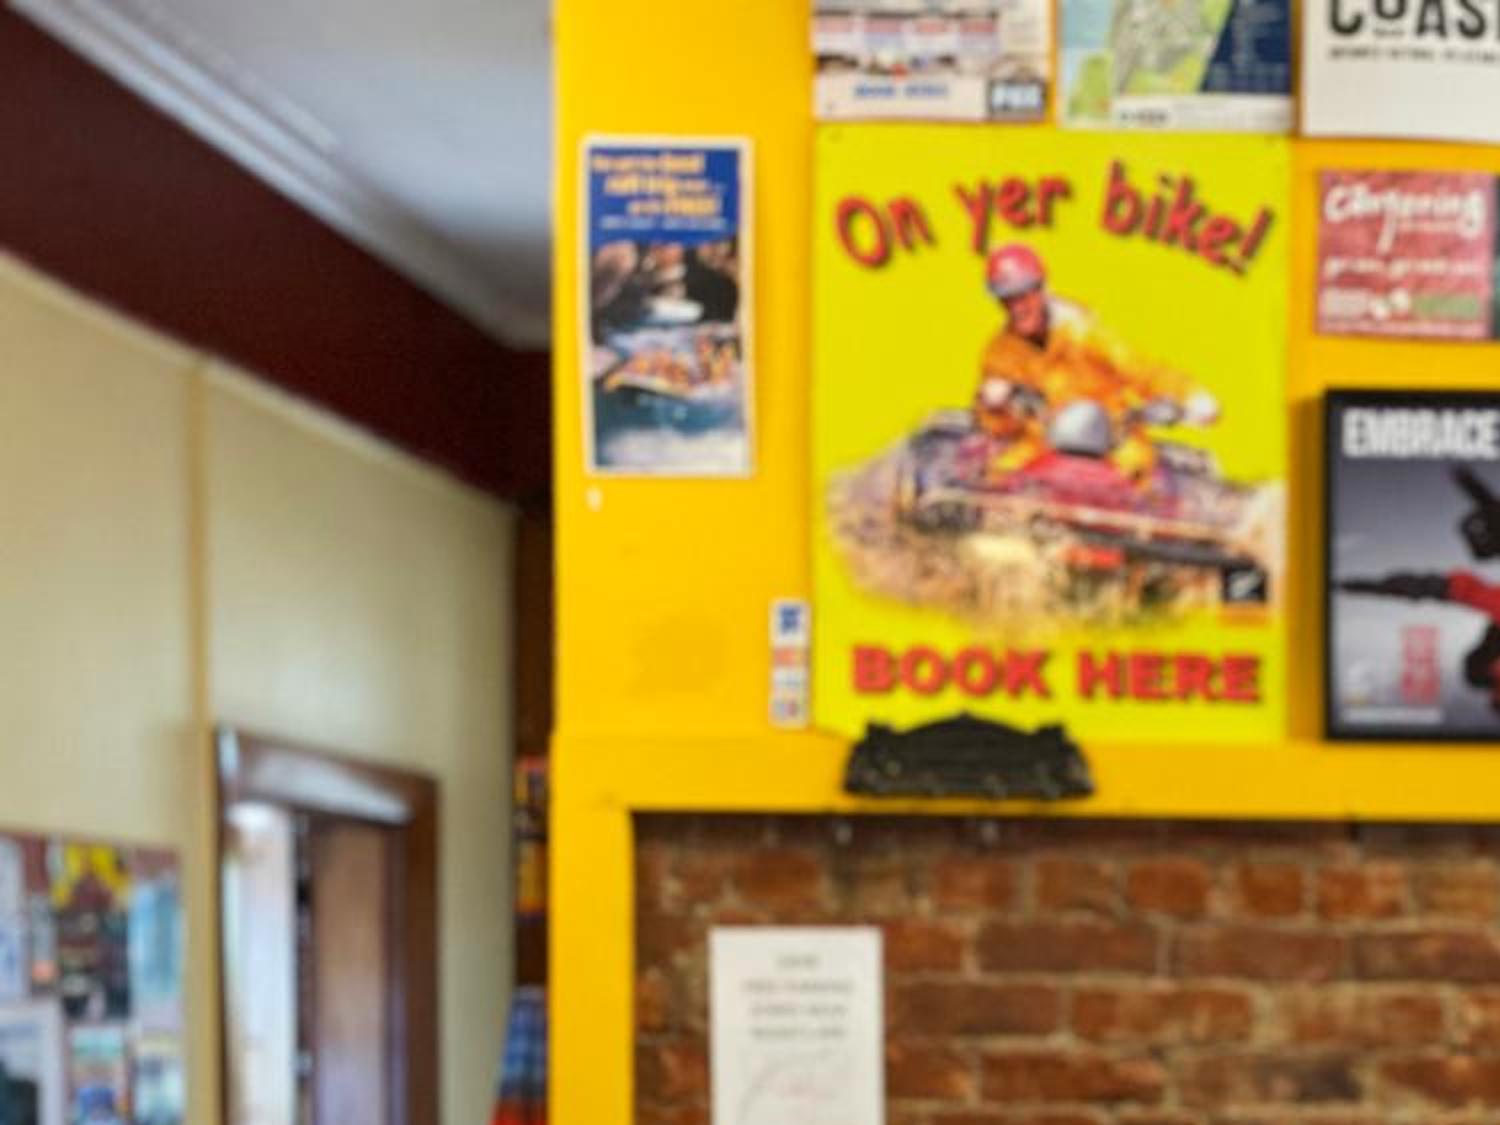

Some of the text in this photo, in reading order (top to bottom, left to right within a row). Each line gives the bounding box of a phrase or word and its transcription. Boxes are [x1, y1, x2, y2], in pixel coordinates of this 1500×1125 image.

[836, 158, 1275, 277] On yer bike!
[1342, 409, 1500, 459] EMBRACE
[852, 644, 1262, 705] BOOK HERE
